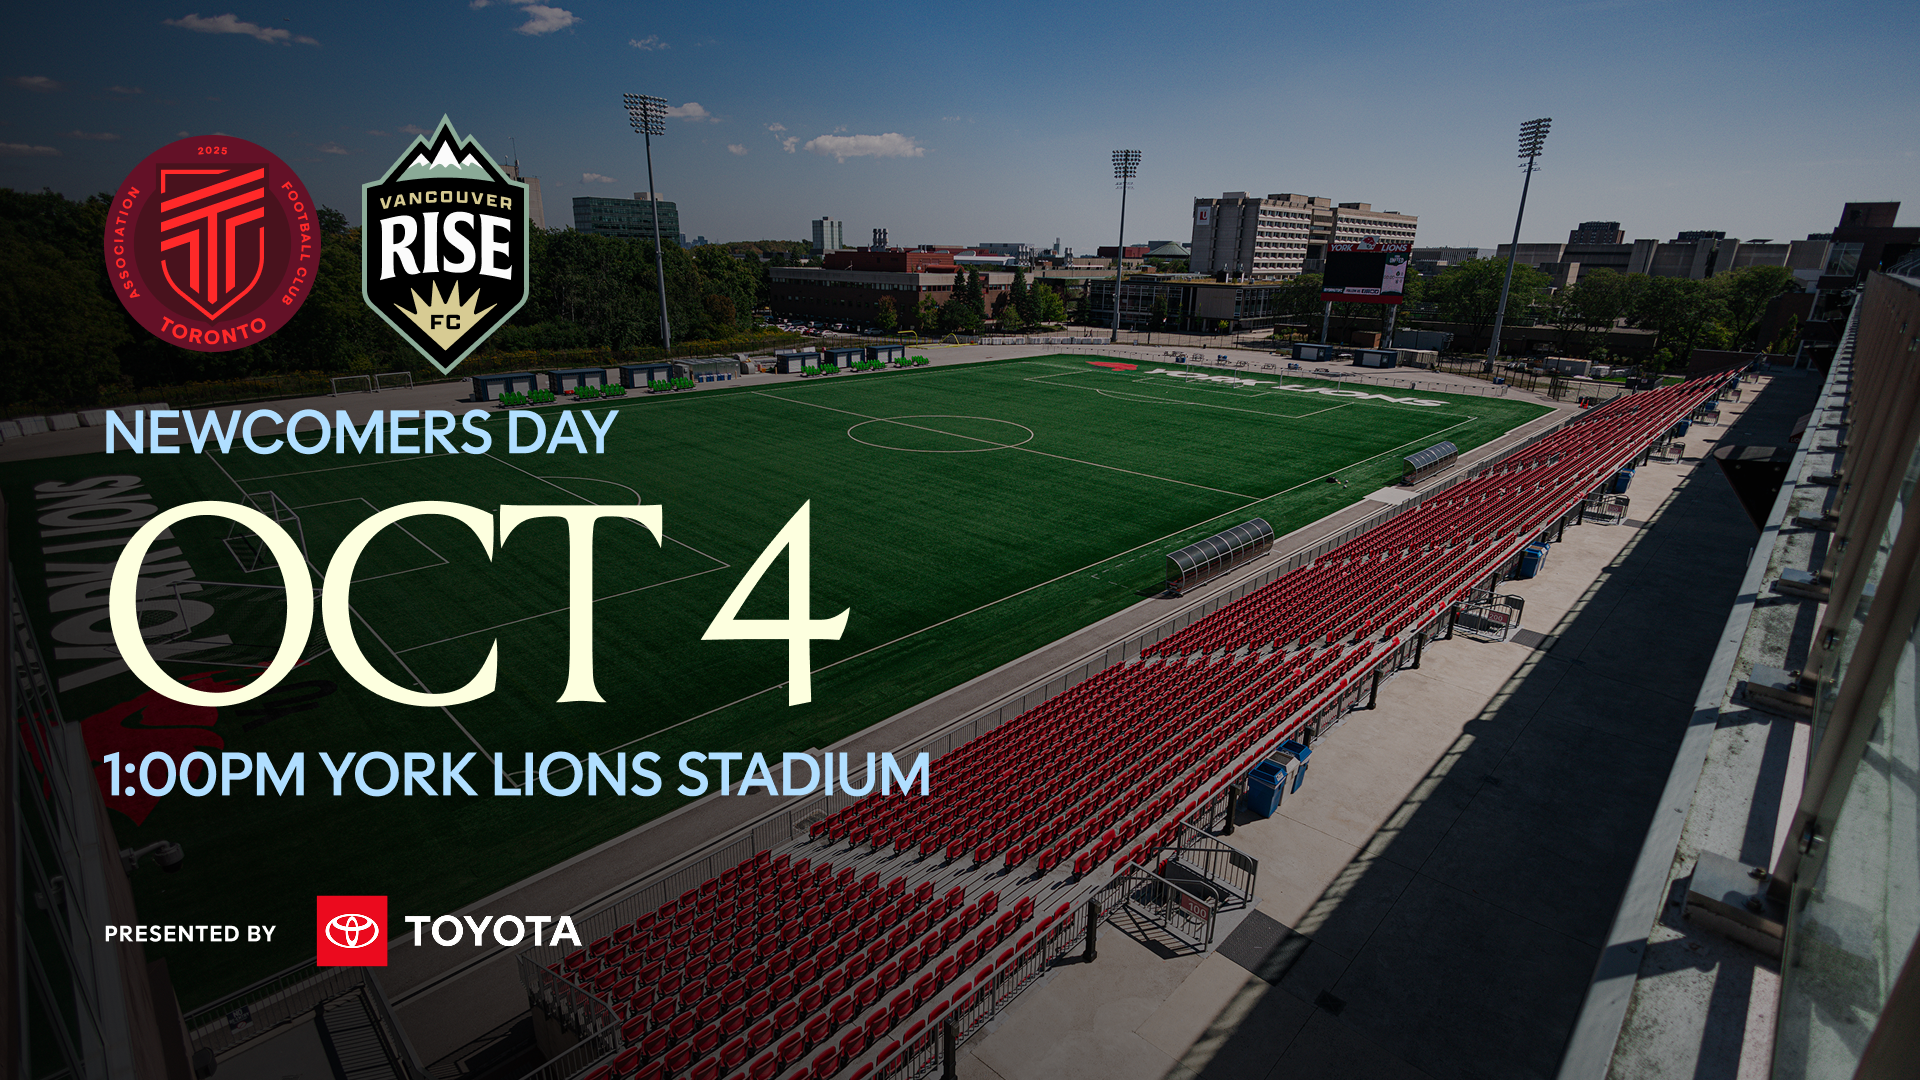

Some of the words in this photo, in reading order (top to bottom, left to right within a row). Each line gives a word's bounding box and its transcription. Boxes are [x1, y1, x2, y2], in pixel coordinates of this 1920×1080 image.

[1331, 244, 1354, 252] YORK
[1381, 244, 1408, 252] LIONS
[1489, 613, 1503, 622] 200
[1188, 902, 1207, 918] 100
